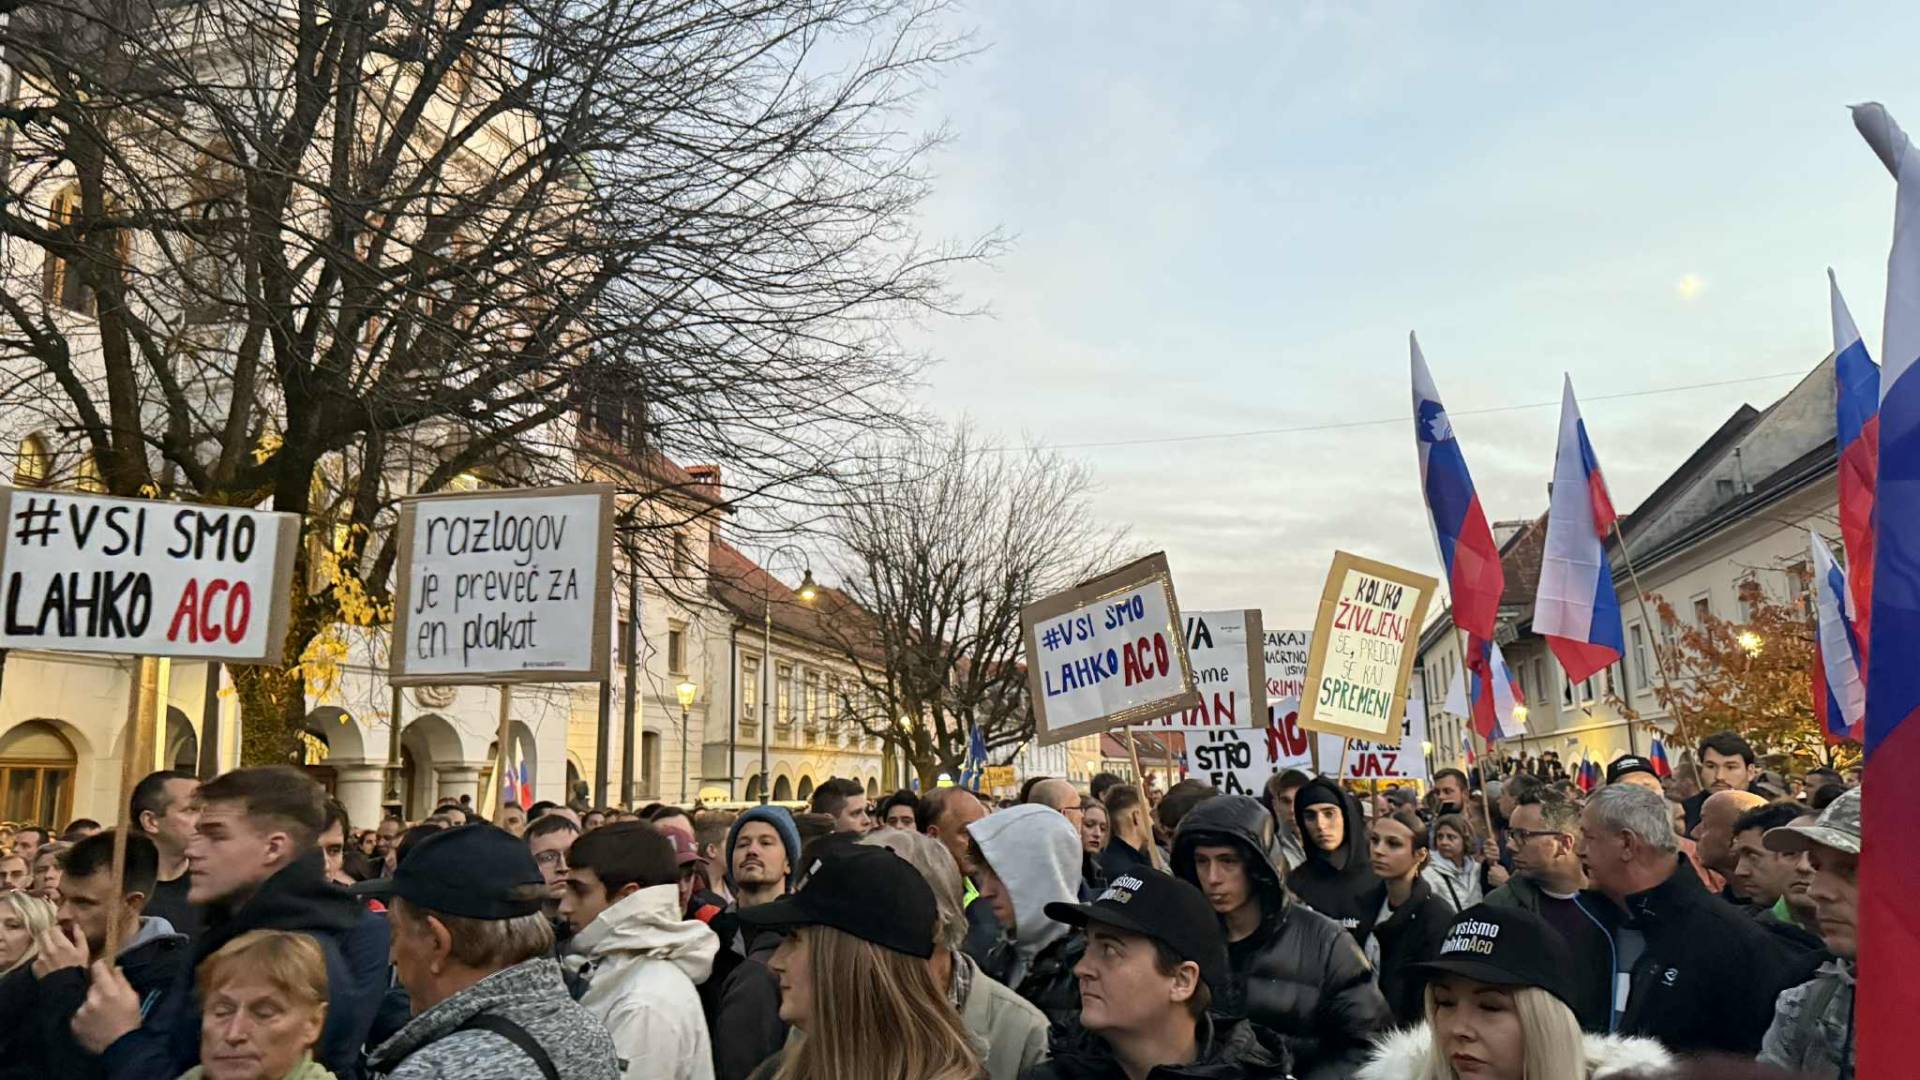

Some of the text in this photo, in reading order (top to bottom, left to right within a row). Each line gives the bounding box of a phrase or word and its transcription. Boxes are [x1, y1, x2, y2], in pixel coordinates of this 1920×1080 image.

[15, 498, 256, 563] #VSI SMO
[427, 510, 567, 566] razlogov
[5, 571, 250, 644] LAHKO ACO
[416, 564, 578, 615] je preveč ZA
[1355, 577, 1403, 610] KOLIKO
[418, 611, 537, 668] en plakat
[1042, 594, 1144, 651] #VSI SMO
[1334, 597, 1409, 643] ŽIVLJENJ
[1045, 632, 1170, 697] LAHKO ACO
[1320, 677, 1391, 720] SPREMENI
[1195, 741, 1251, 770] STRO
[1350, 753, 1407, 777] JAZ.
